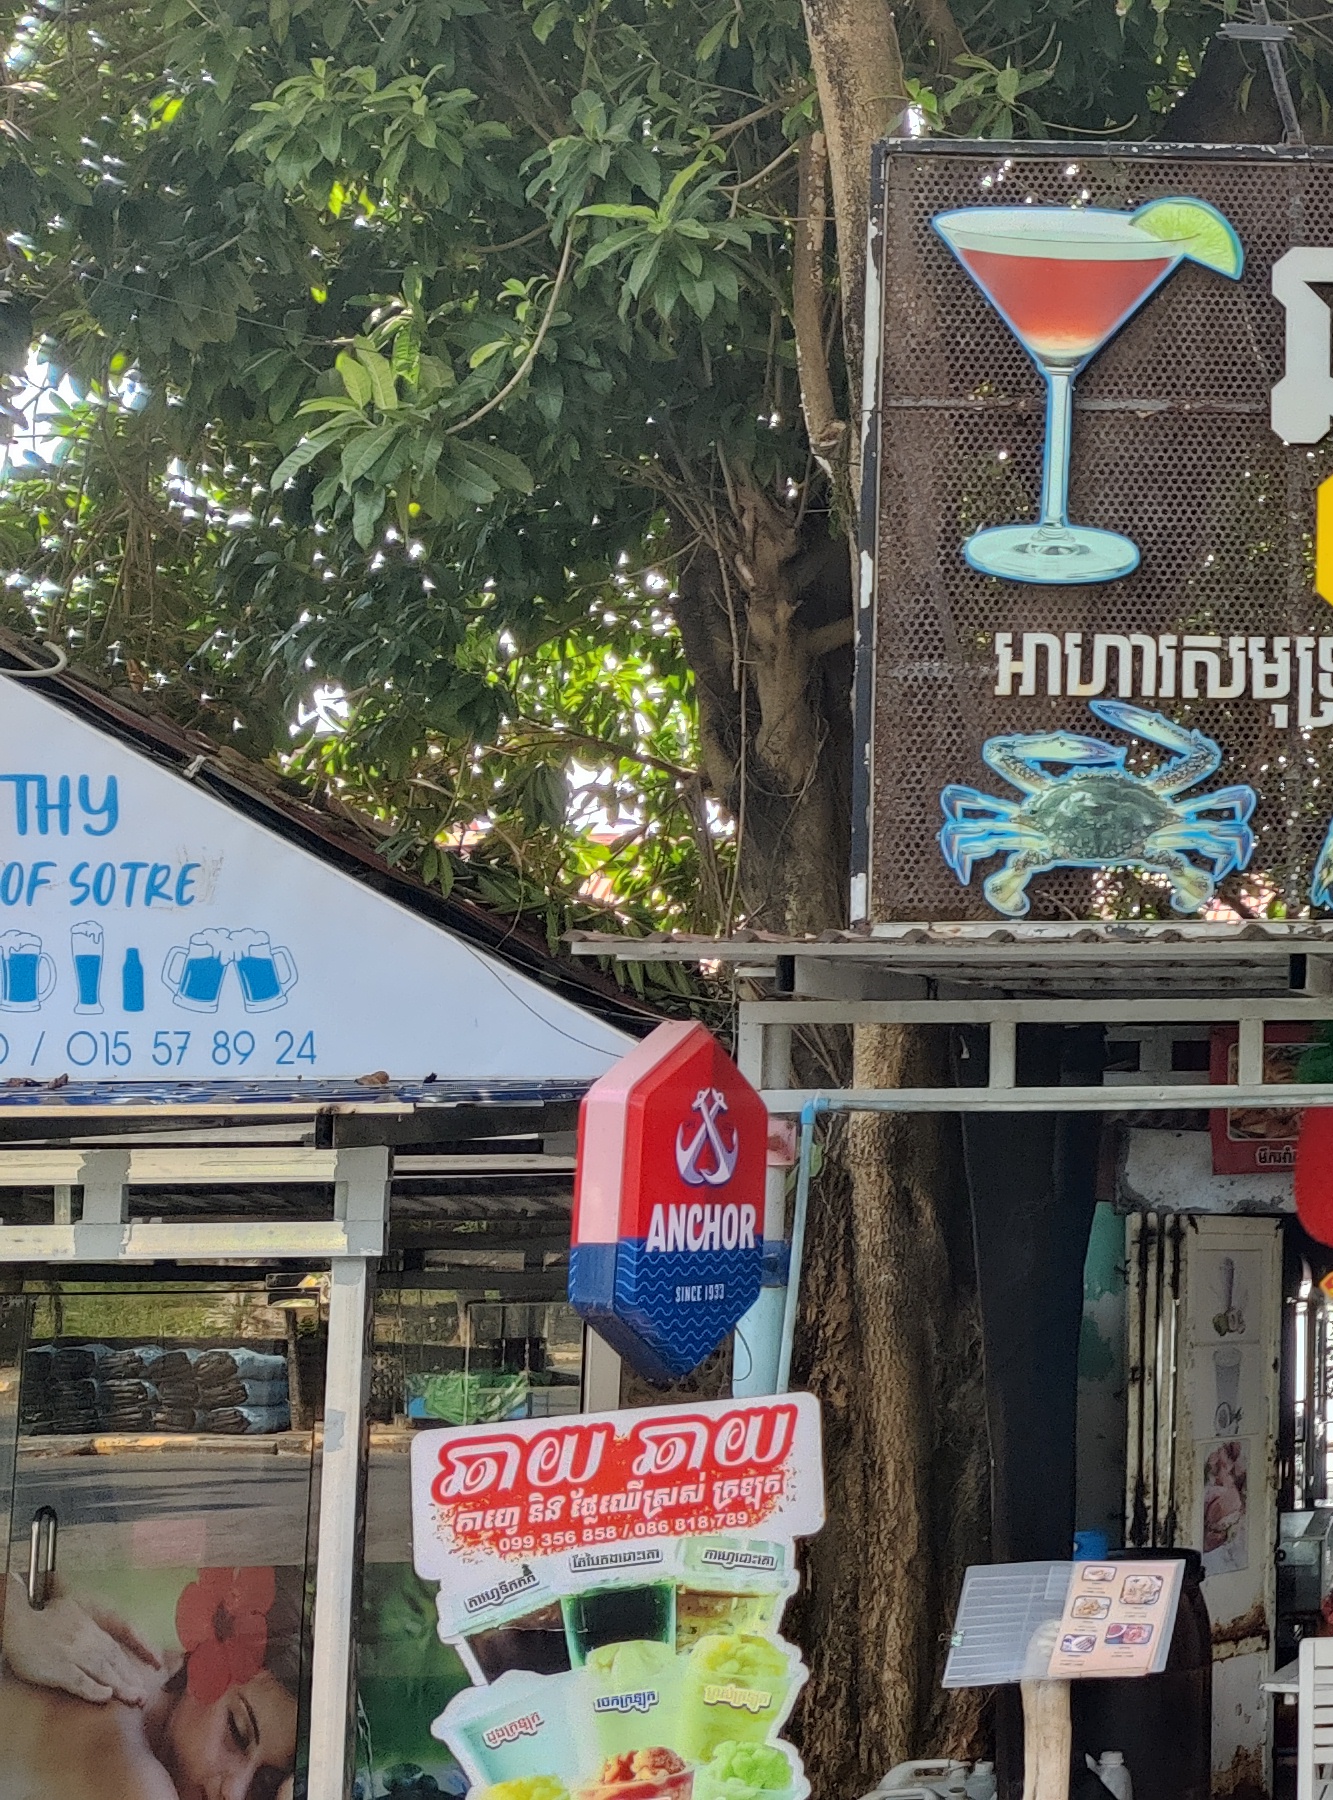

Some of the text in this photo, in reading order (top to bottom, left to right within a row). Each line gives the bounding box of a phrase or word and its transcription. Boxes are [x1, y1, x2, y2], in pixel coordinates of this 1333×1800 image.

[69, 861, 202, 907] SOTRE
[67, 1030, 131, 1066] 015
[152, 1030, 191, 1066] 57
[212, 1030, 255, 1066] 89
[275, 1030, 317, 1066] 24
[645, 1203, 757, 1254] ANCHOR
[675, 1284, 702, 1303] SINCE
[437, 1408, 792, 1500] ឆាយ ឆាយ
[498, 1534, 536, 1552] 099
[540, 1530, 577, 1547] 356
[581, 1525, 617, 1542] 858
[633, 1520, 670, 1537] 086
[674, 1515, 709, 1532] 818
[713, 1511, 749, 1528] 789
